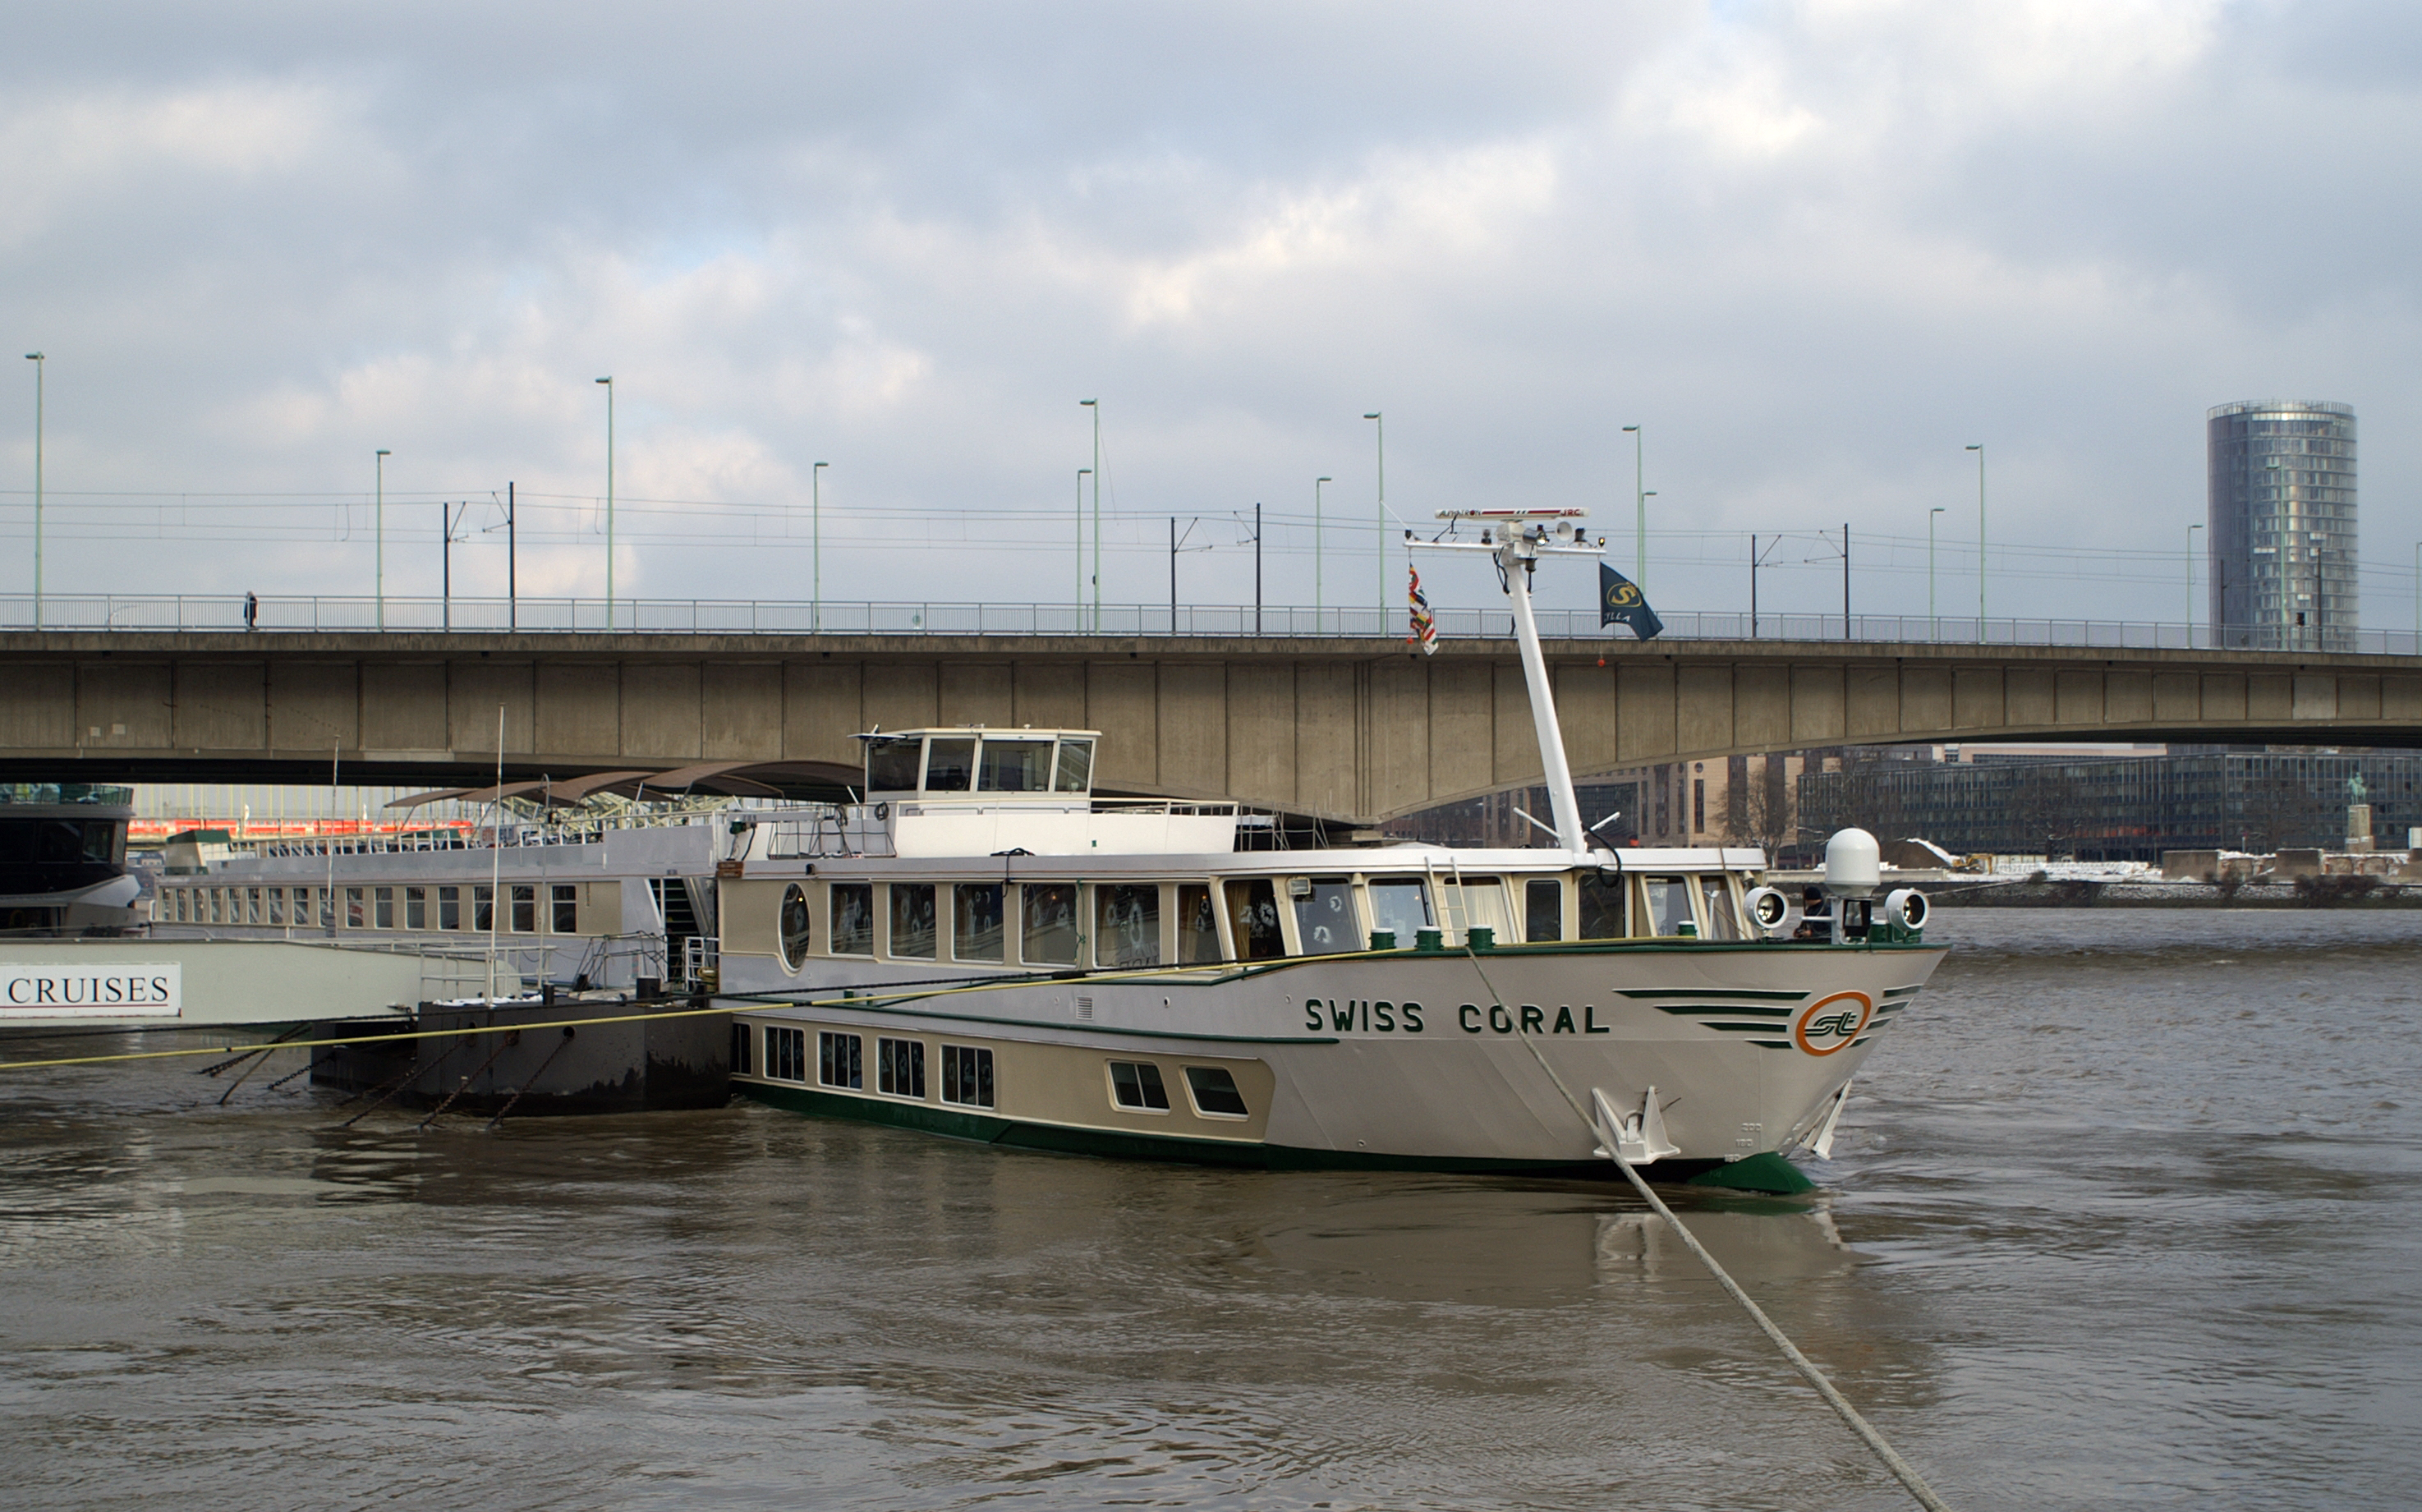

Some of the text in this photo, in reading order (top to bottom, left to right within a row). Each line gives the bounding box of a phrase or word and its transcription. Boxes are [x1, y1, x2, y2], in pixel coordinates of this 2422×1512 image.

[1560, 508, 1581, 517] JRC
[7, 976, 168, 1004] CRUISES
[1304, 997, 1611, 1035] SWISS CORAL
